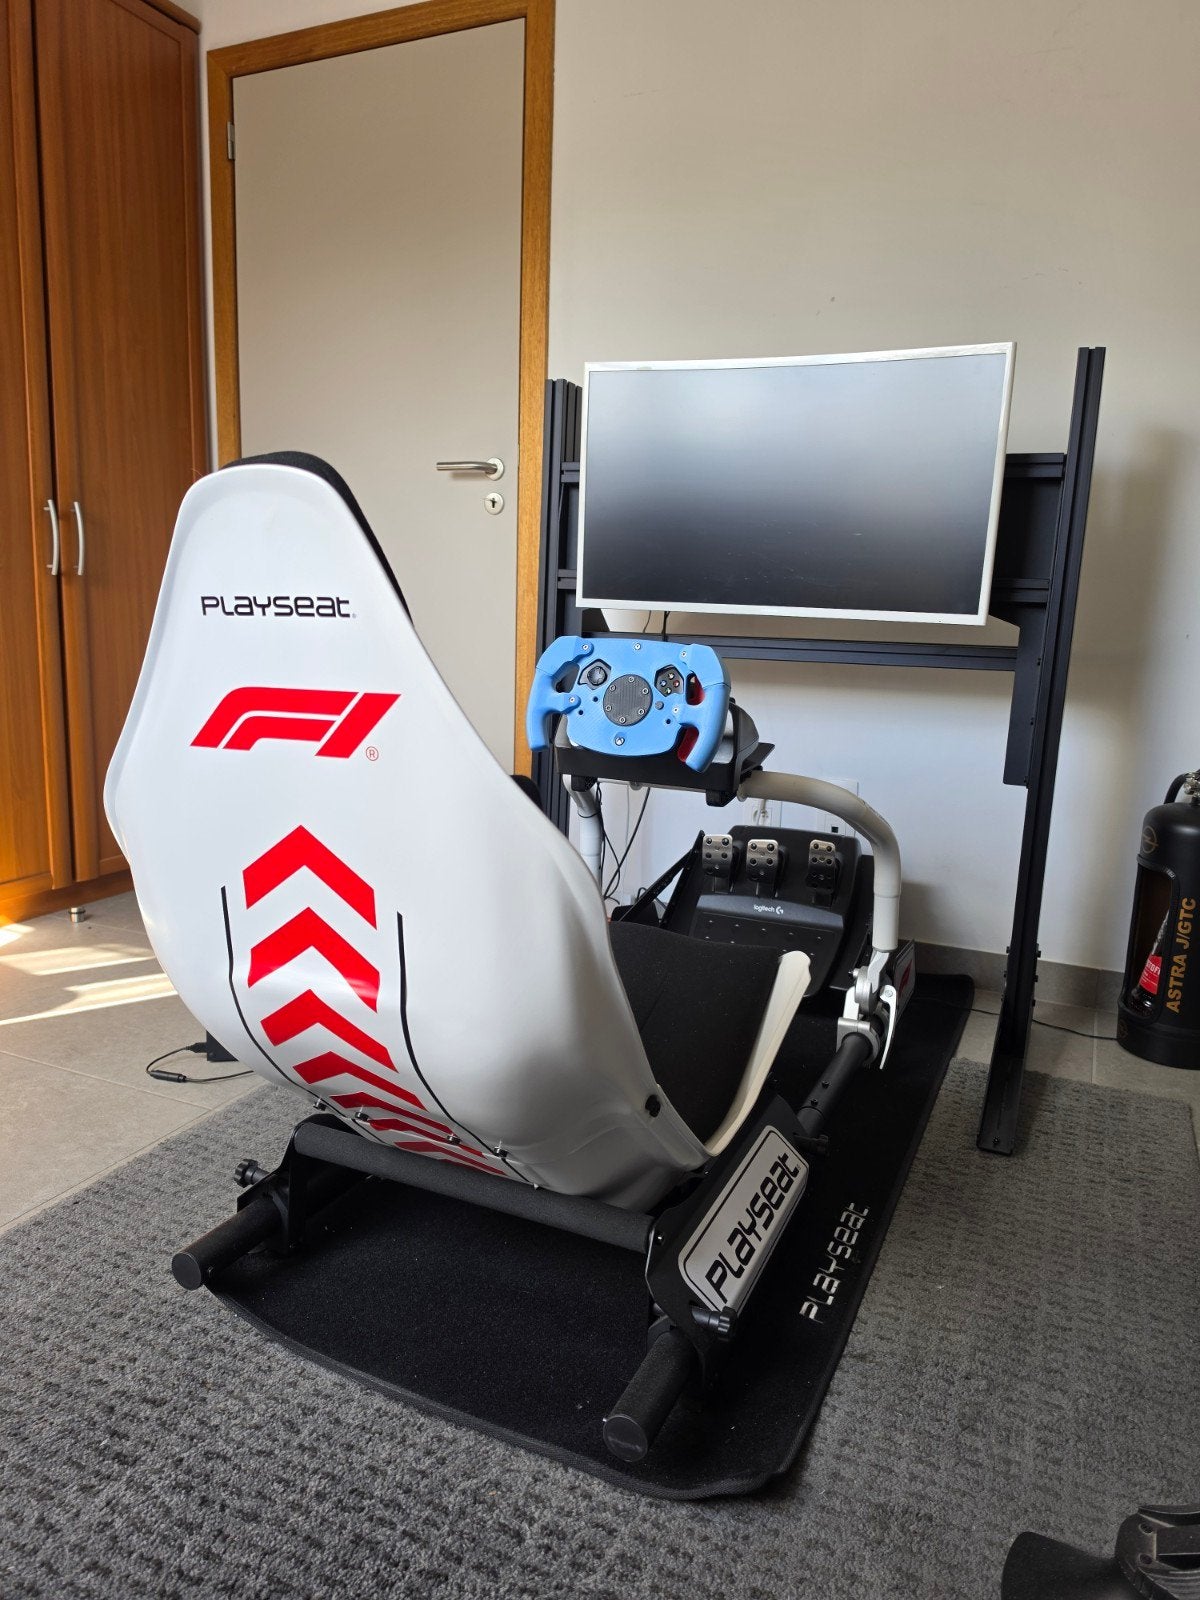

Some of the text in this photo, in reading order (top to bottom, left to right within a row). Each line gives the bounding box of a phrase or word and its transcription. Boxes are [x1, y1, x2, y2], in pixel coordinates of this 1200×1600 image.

[190, 686, 402, 758] F1
[753, 904, 775, 913] logitech
[1165, 897, 1196, 1014] ASTRA J/GTC
